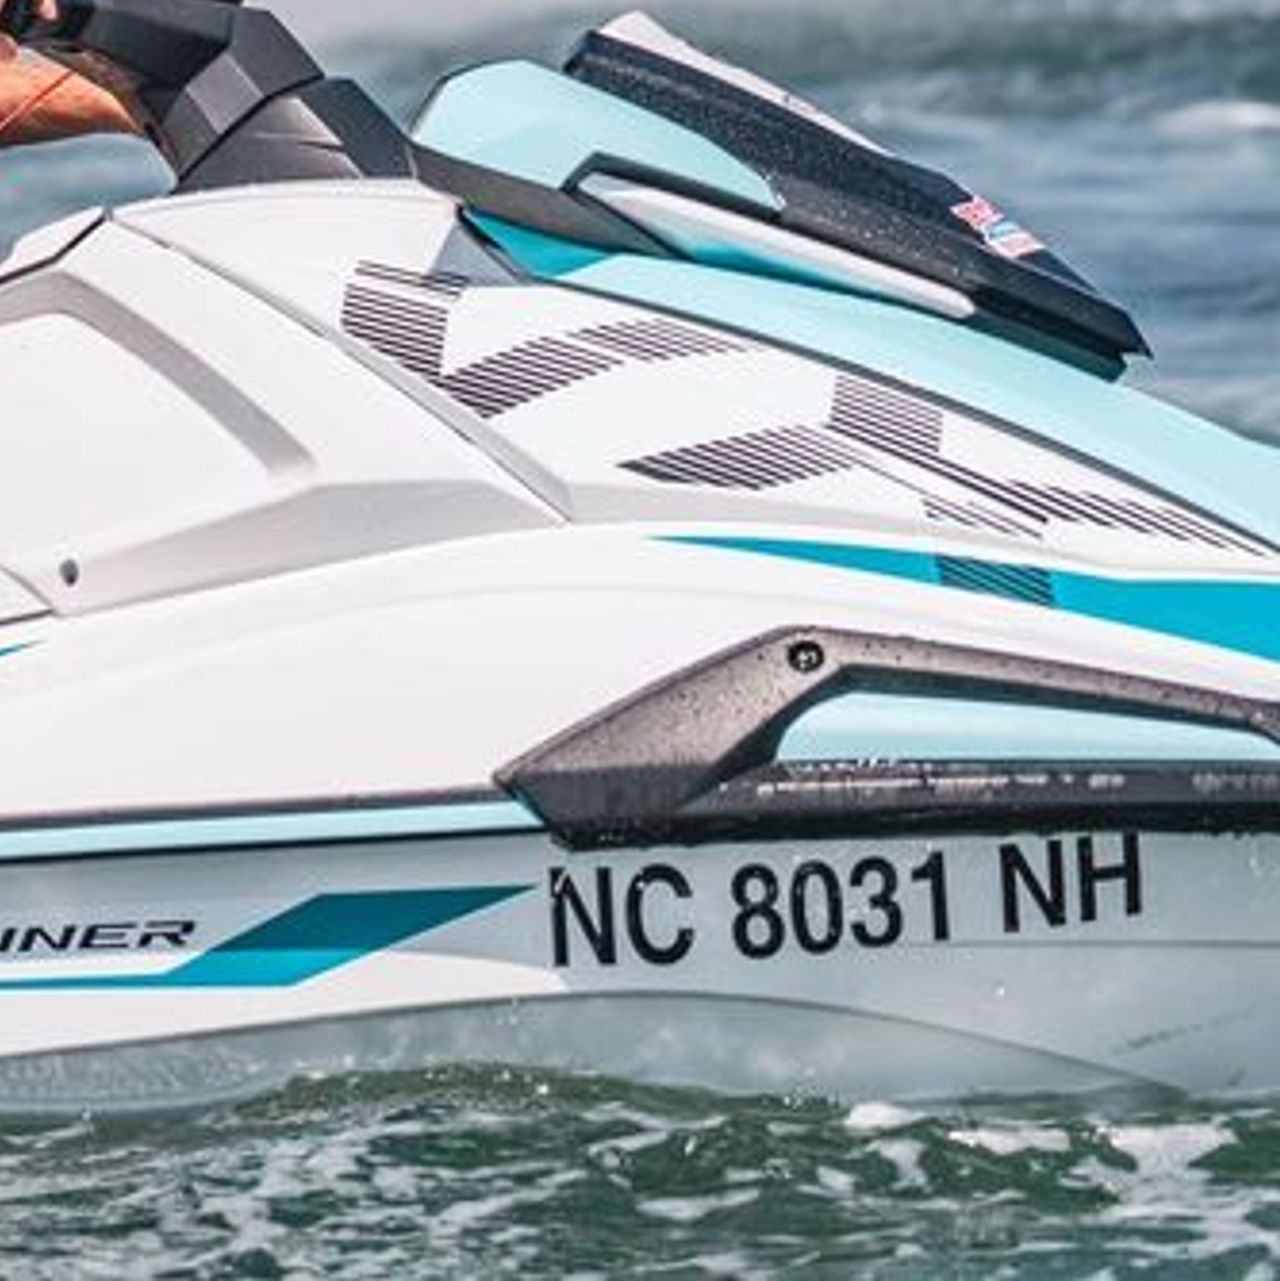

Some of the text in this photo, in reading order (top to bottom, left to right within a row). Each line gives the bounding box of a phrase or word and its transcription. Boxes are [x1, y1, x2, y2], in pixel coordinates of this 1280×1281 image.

[548, 832, 1144, 968] NC 8031 NH
